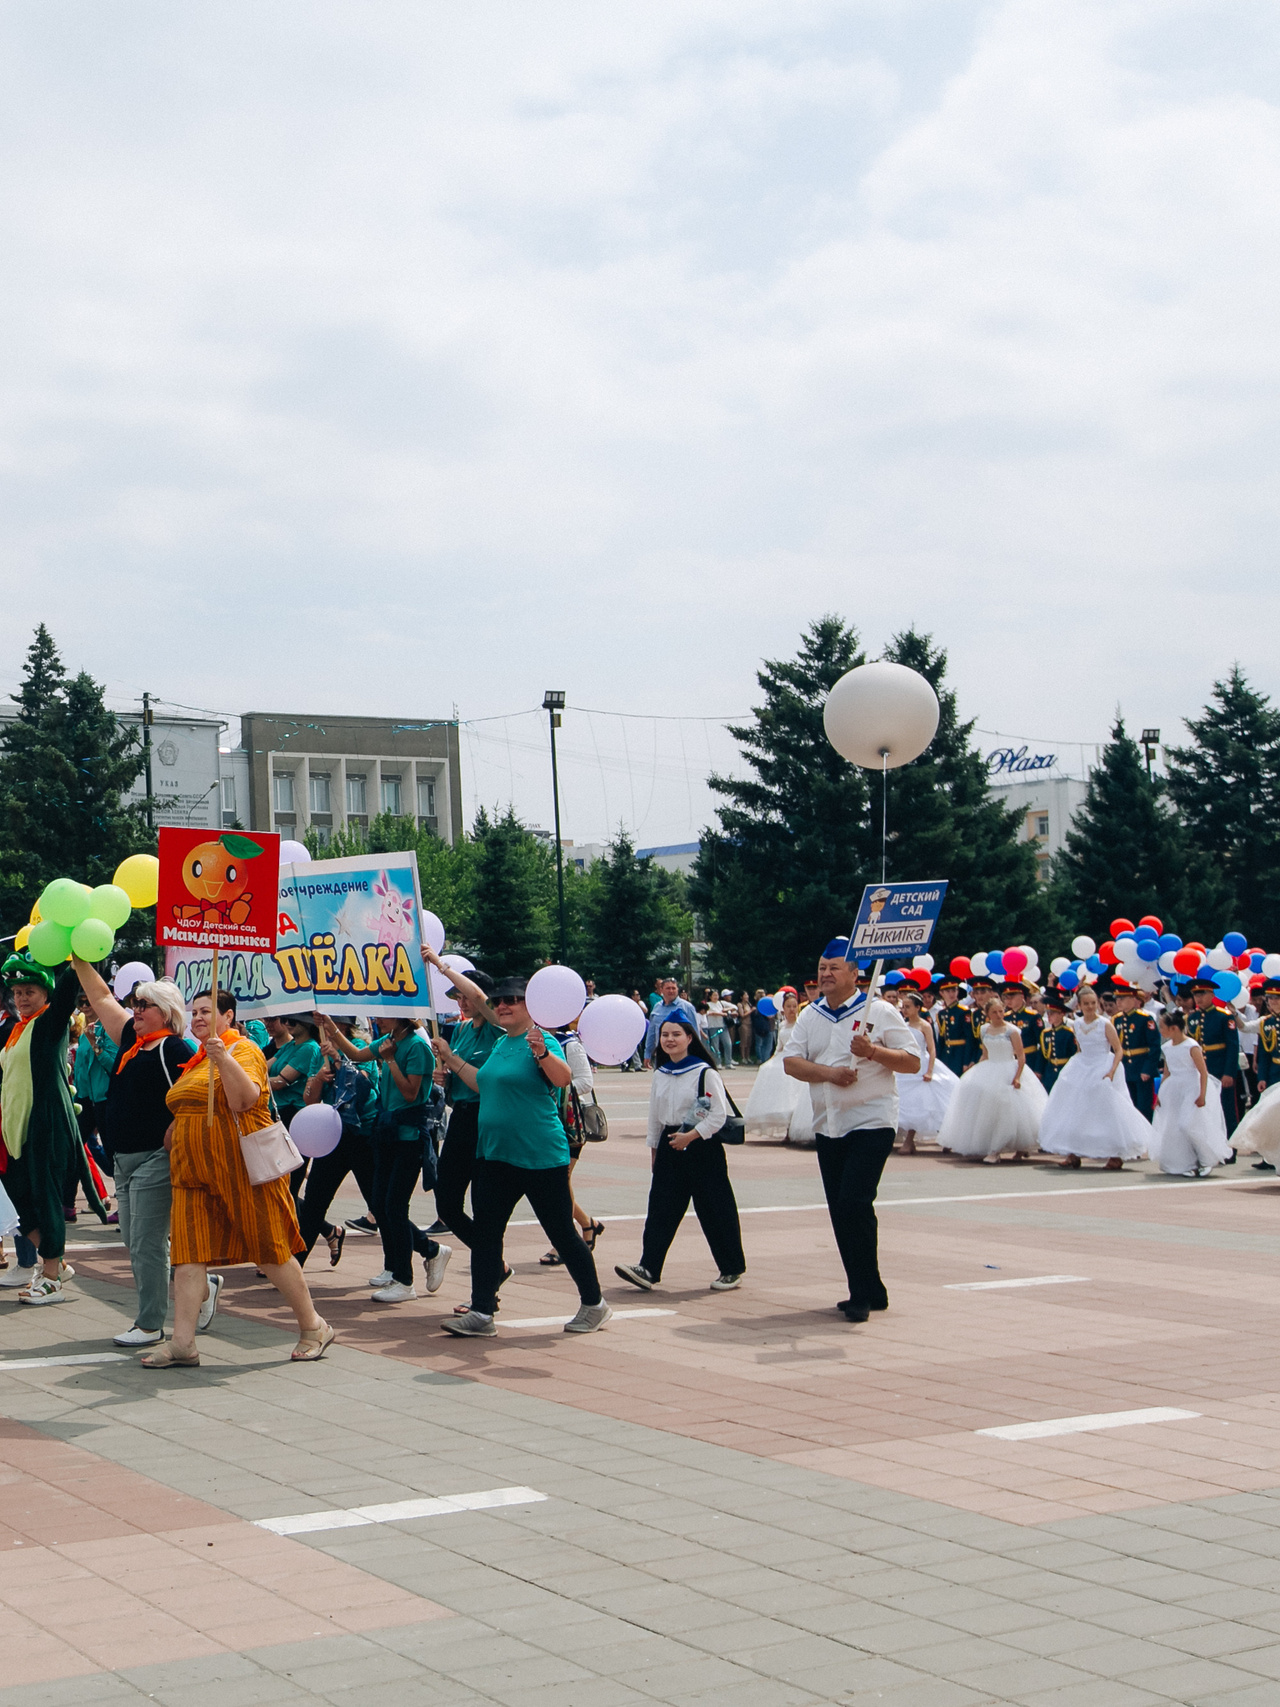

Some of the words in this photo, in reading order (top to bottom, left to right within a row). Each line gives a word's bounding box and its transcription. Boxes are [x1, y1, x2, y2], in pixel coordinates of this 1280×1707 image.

[986, 745, 1057, 775] Plaza
[890, 889, 940, 905] ДЕТСКИЙ
[901, 904, 923, 915] САД
[177, 918, 202, 929] ЧДОУ
[203, 920, 239, 932] Детский
[240, 924, 257, 934] сад
[163, 926, 271, 949] Мандаринка
